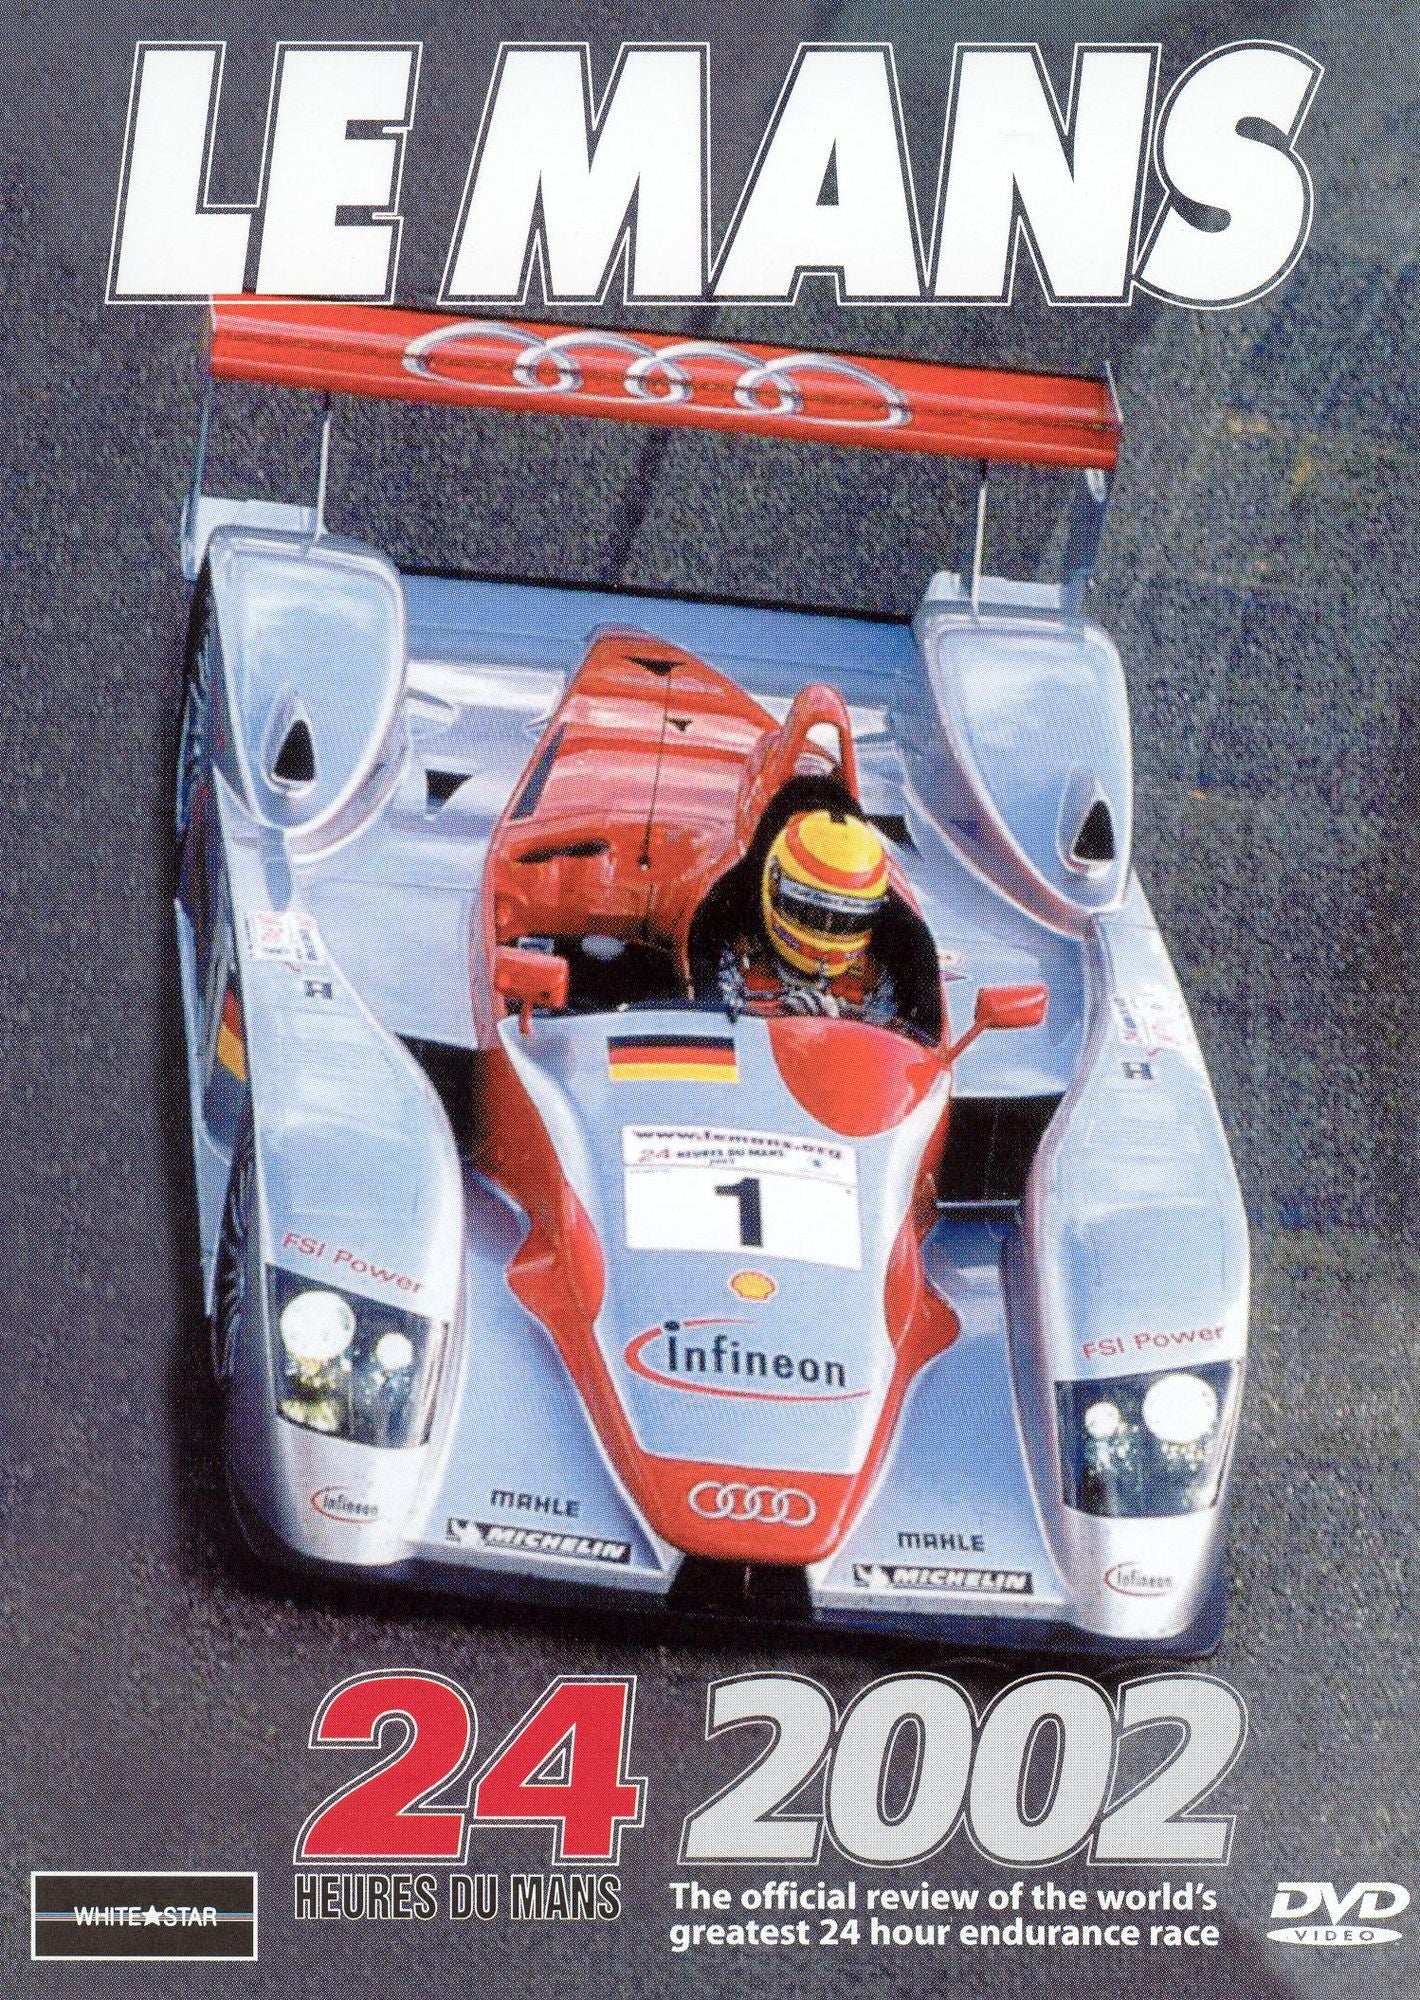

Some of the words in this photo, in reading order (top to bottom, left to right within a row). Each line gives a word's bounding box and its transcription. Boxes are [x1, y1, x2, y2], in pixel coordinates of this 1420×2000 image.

[105, 41, 423, 305] LE
[437, 40, 1326, 310] MANS
[714, 1176, 764, 1248] 1
[283, 1231, 327, 1258] FSI
[333, 1248, 424, 1294] Power
[1082, 1336, 1126, 1360] FSI
[1133, 1326, 1225, 1351] Power
[490, 1489, 580, 1518] MAHLE
[486, 1526, 627, 1560] MICHELIN
[898, 1531, 985, 1552] MAHLE
[893, 1568, 1028, 1592] MICHELIN
[293, 1668, 648, 1866] 24
[677, 1671, 1249, 1868] 2002
[294, 1873, 437, 1921] HEURES
[449, 1873, 499, 1921] DU
[510, 1873, 622, 1921] MANS
[669, 1881, 732, 1910] The
[741, 1881, 856, 1910] official
[867, 1881, 979, 1910] review
[988, 1881, 1024, 1910] of
[1031, 1882, 1088, 1910] the
[1097, 1882, 1218, 1911] world's
[1270, 1881, 1411, 1926] DVD
[669, 1919, 810, 1952] greatest
[819, 1918, 861, 1946] 24
[870, 1917, 951, 1946] hour
[959, 1917, 1141, 1946] endurance
[1150, 1925, 1220, 1946] race
[1294, 1930, 1375, 1942] VIDEO
